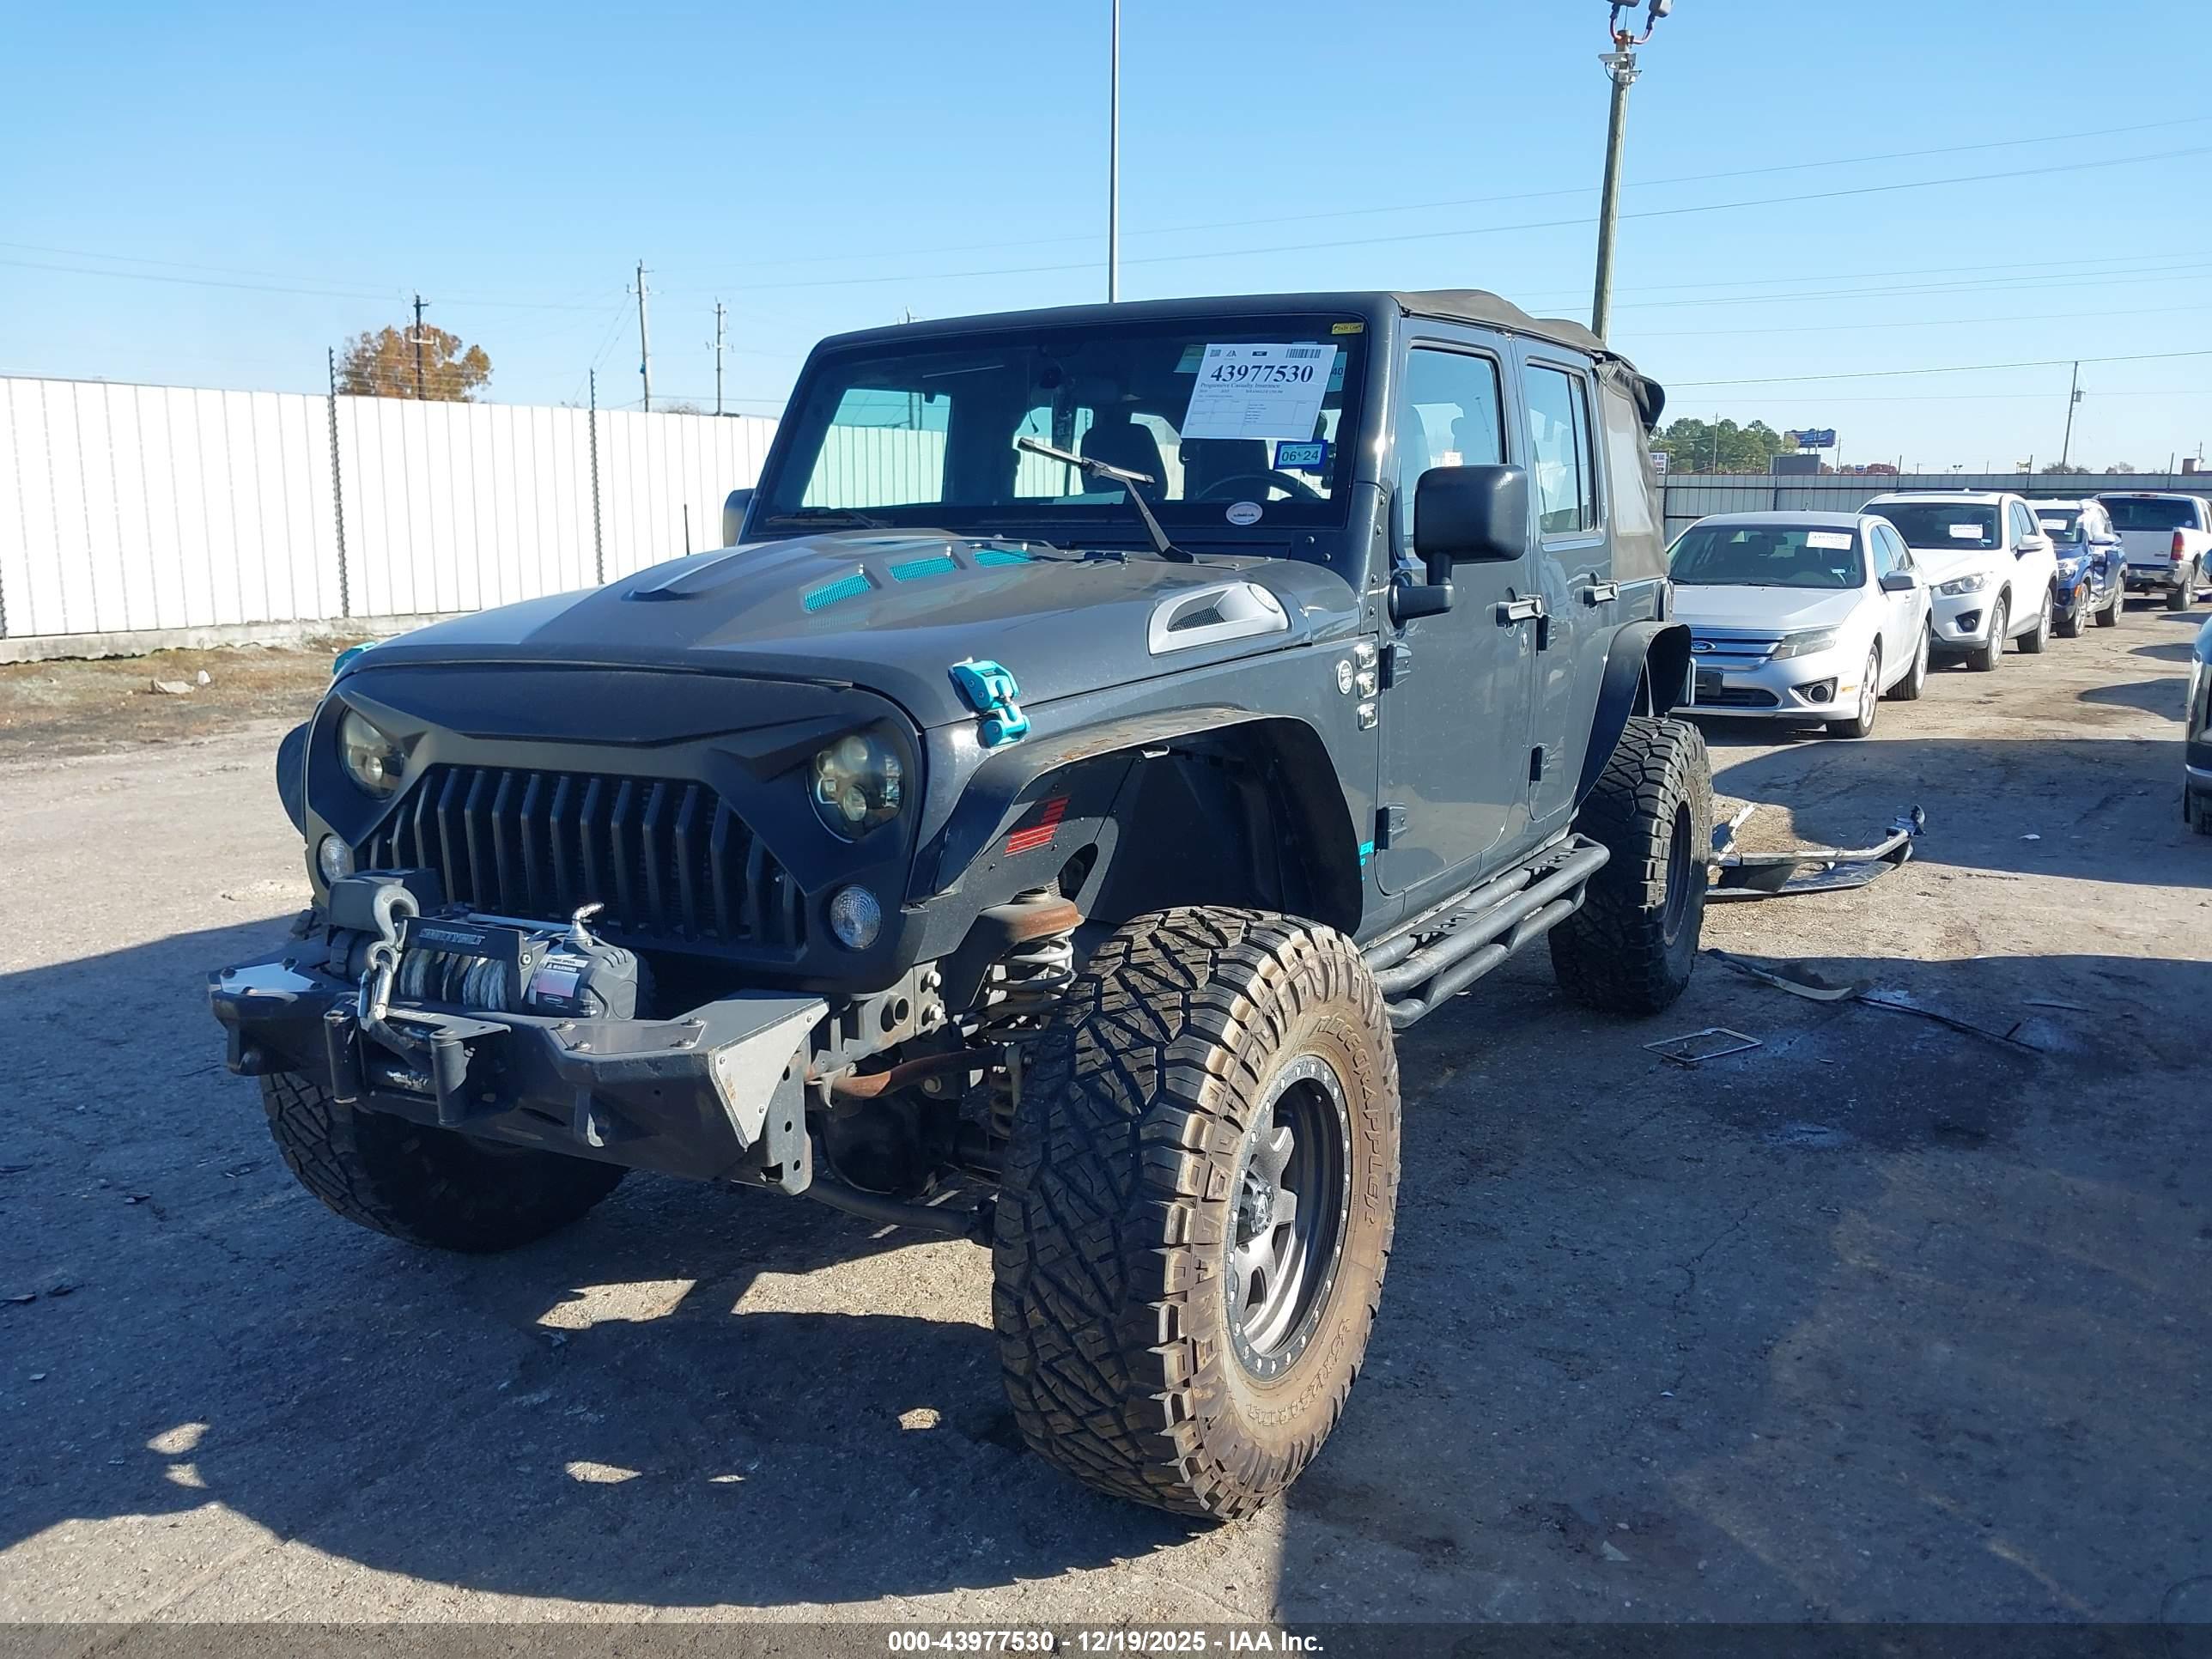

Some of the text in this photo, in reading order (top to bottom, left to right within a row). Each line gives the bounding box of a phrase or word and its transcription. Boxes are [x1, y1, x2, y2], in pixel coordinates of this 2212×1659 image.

[1211, 364, 1314, 382] 43977530
[1281, 450, 1319, 461] 06 24
